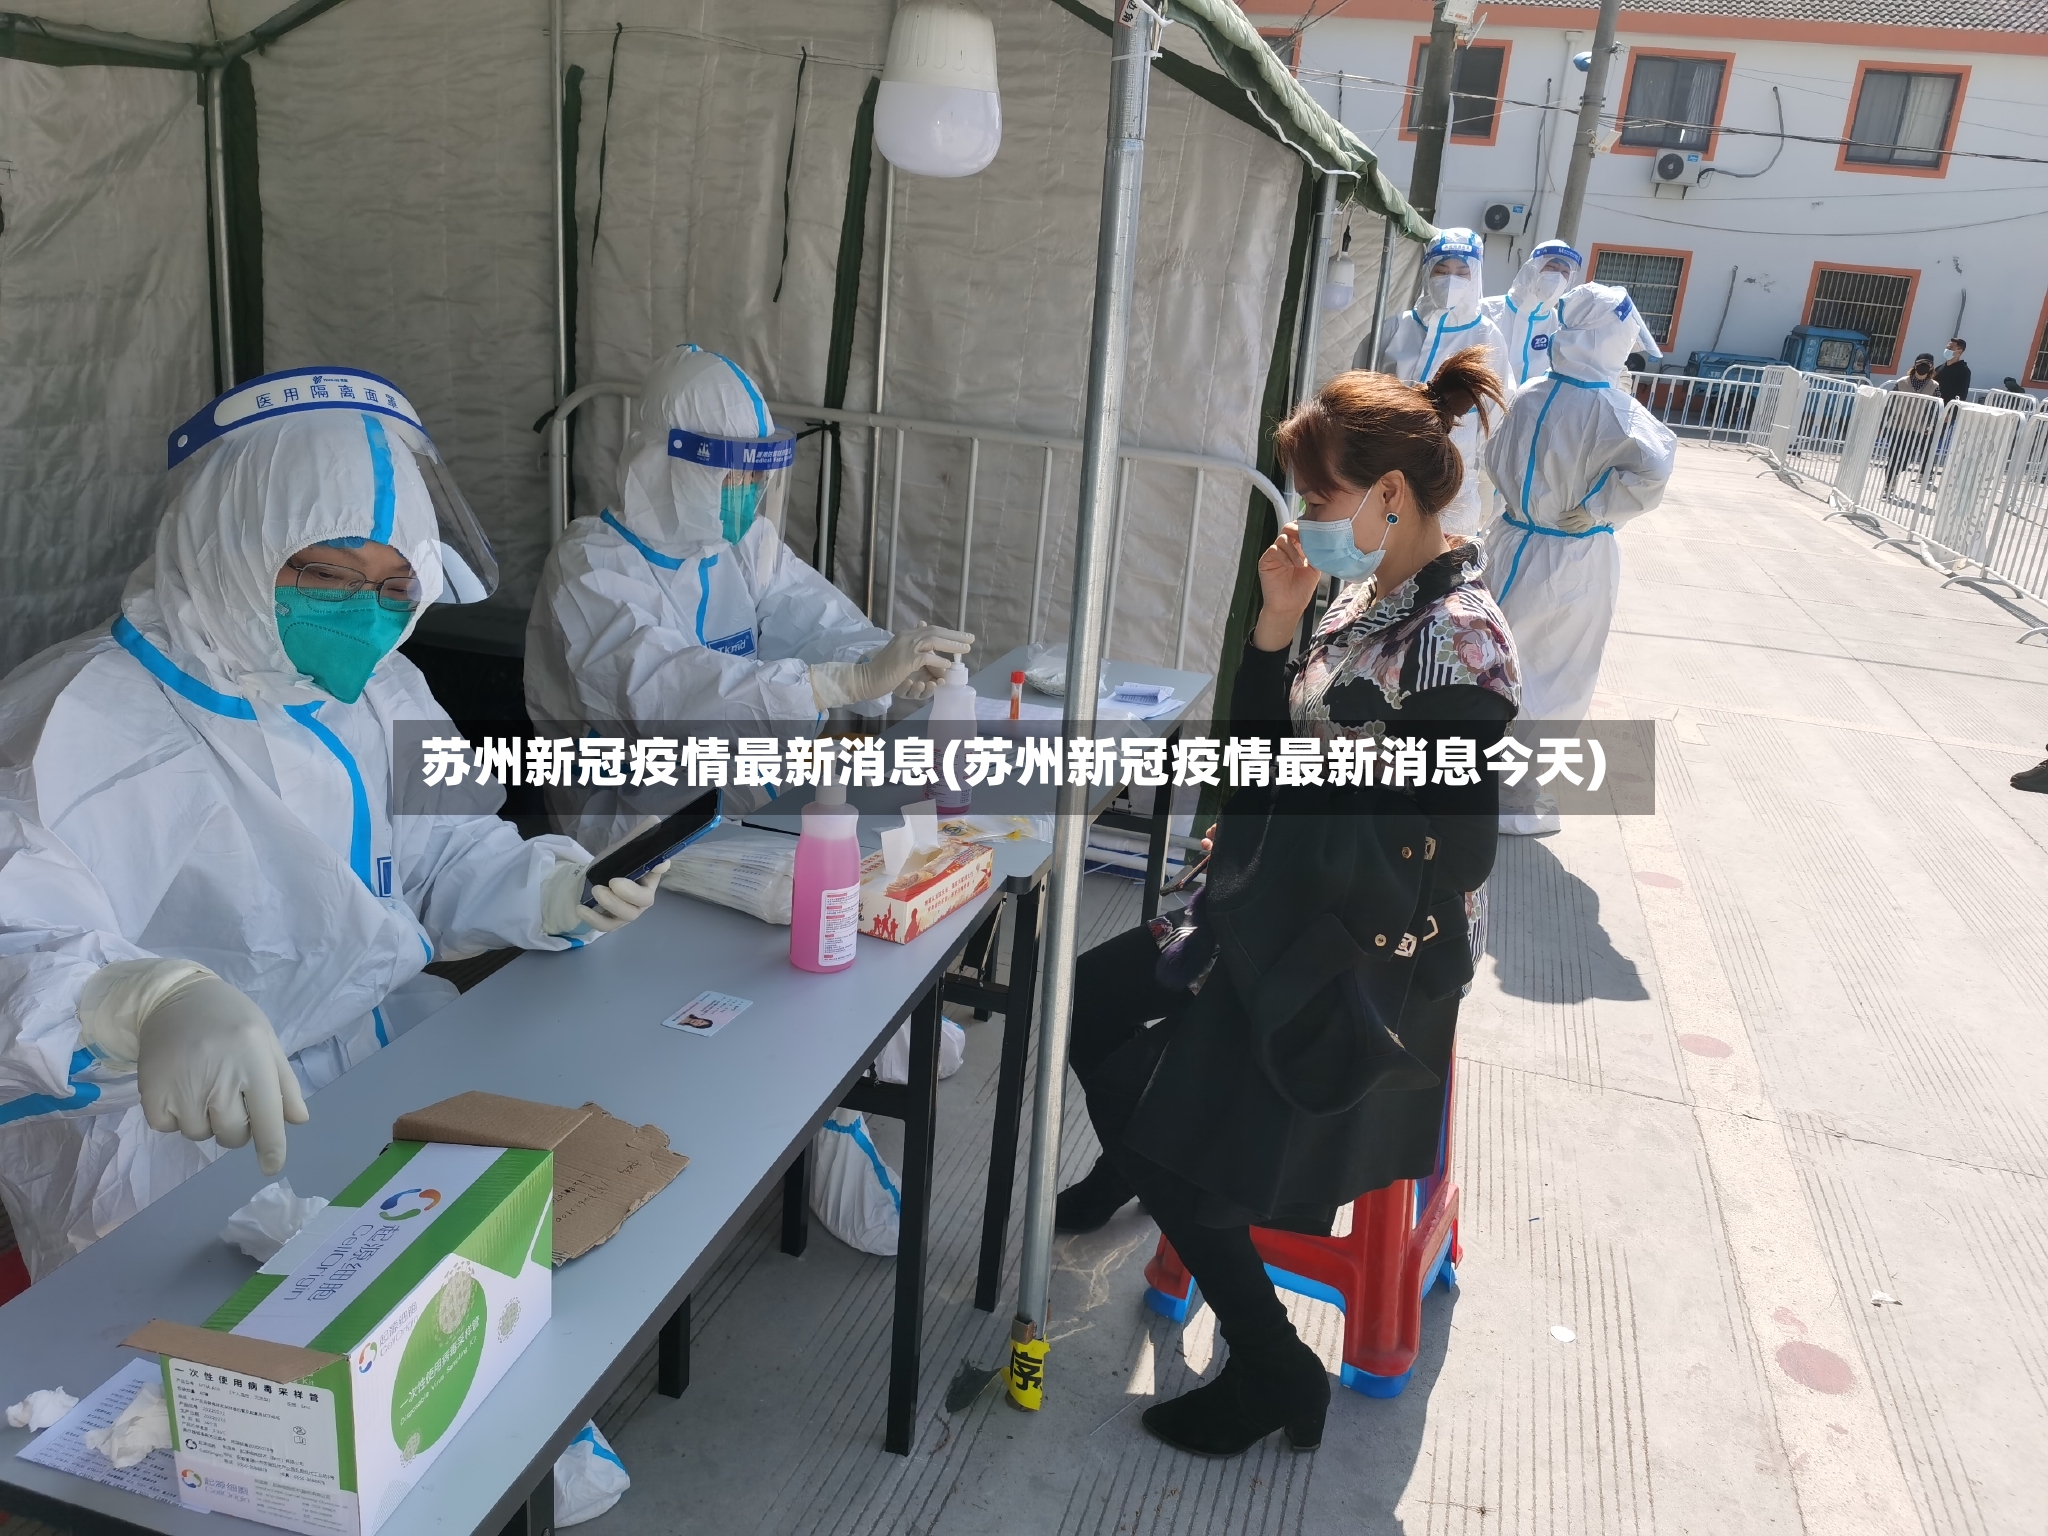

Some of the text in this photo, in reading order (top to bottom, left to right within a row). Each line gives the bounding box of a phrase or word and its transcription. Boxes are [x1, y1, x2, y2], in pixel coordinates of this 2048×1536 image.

[256, 385, 398, 409] 医用隔离面罩
[284, 1224, 374, 1301] CellOrigin
[307, 1224, 400, 1301] 起源细胞
[174, 1366, 320, 1403] 一次性使用病毒采样管
[400, 1314, 480, 1409] 一次性使用病毒采样管
